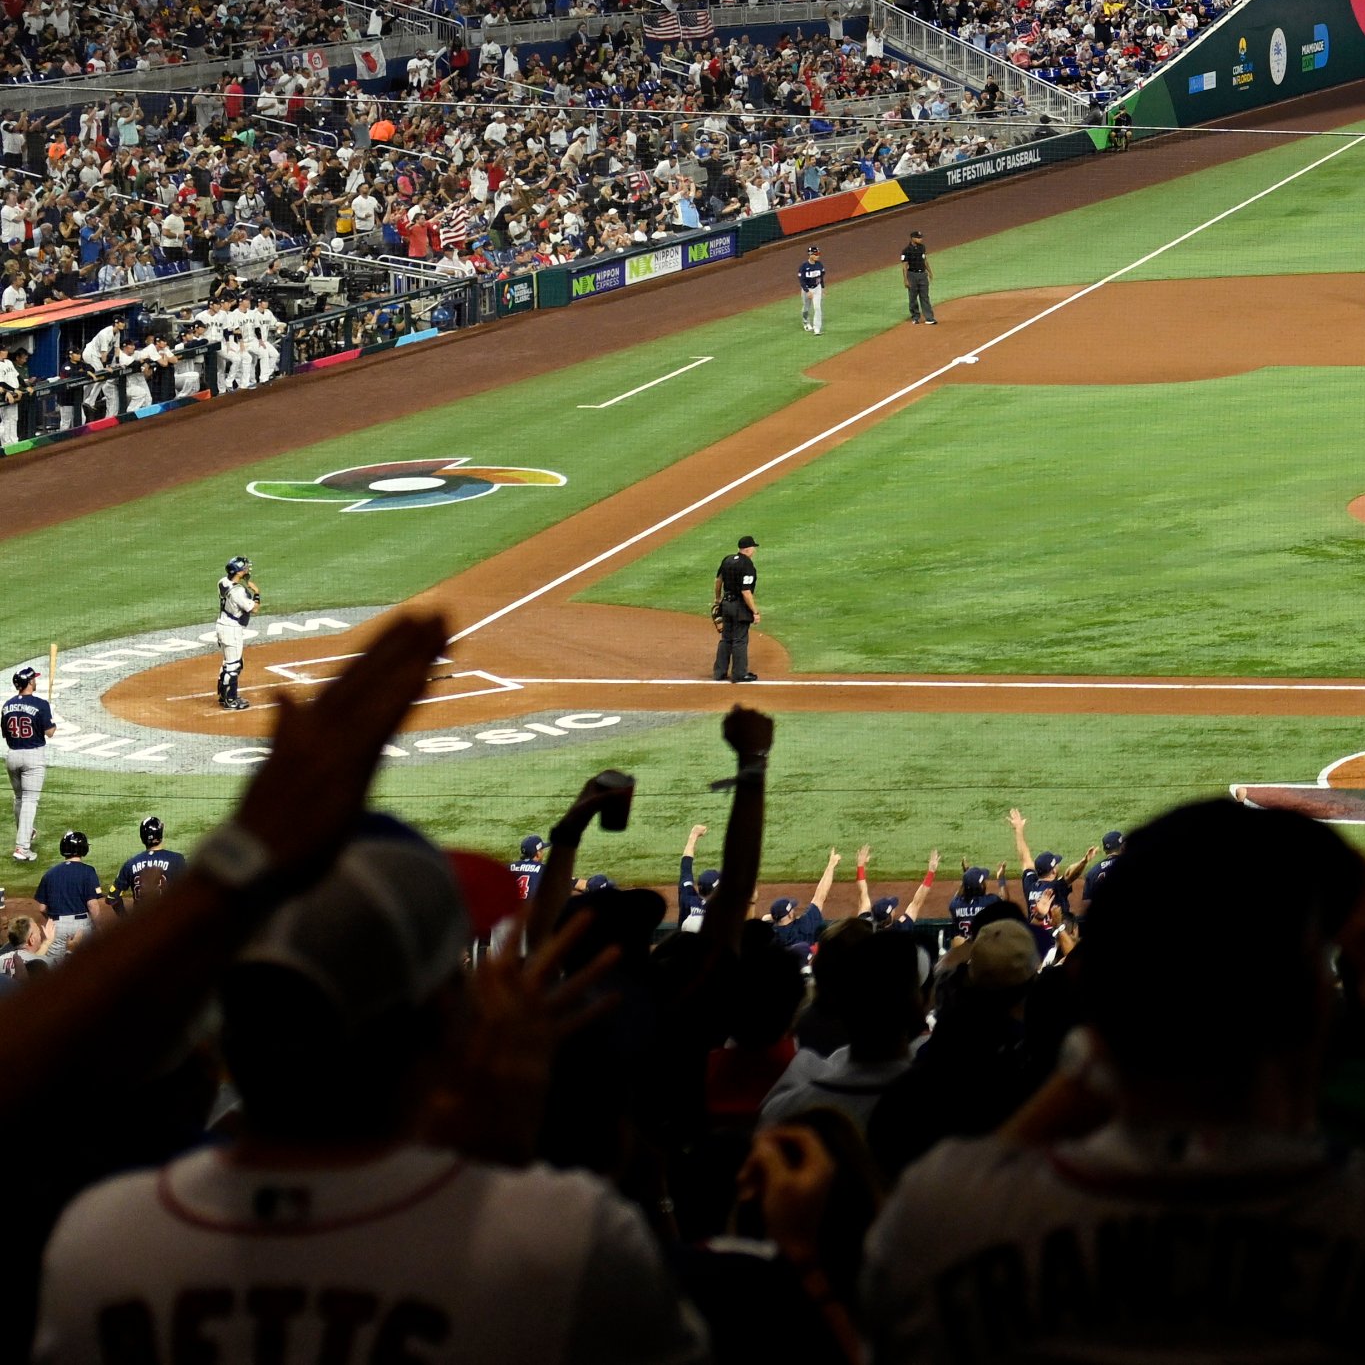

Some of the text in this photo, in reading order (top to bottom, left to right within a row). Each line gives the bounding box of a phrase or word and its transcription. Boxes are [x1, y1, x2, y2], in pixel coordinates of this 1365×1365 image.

[947, 148, 1041, 185] THE FESTIVAL OF BASEBALL
[709, 237, 731, 249] NIPPON
[654, 248, 680, 261] NIPPON
[709, 246, 731, 257] EXPRESS
[654, 258, 680, 271] EXPRESS
[596, 267, 620, 280] NIPPON
[596, 277, 620, 290] EXPRESS
[7, 716, 33, 738] 46
